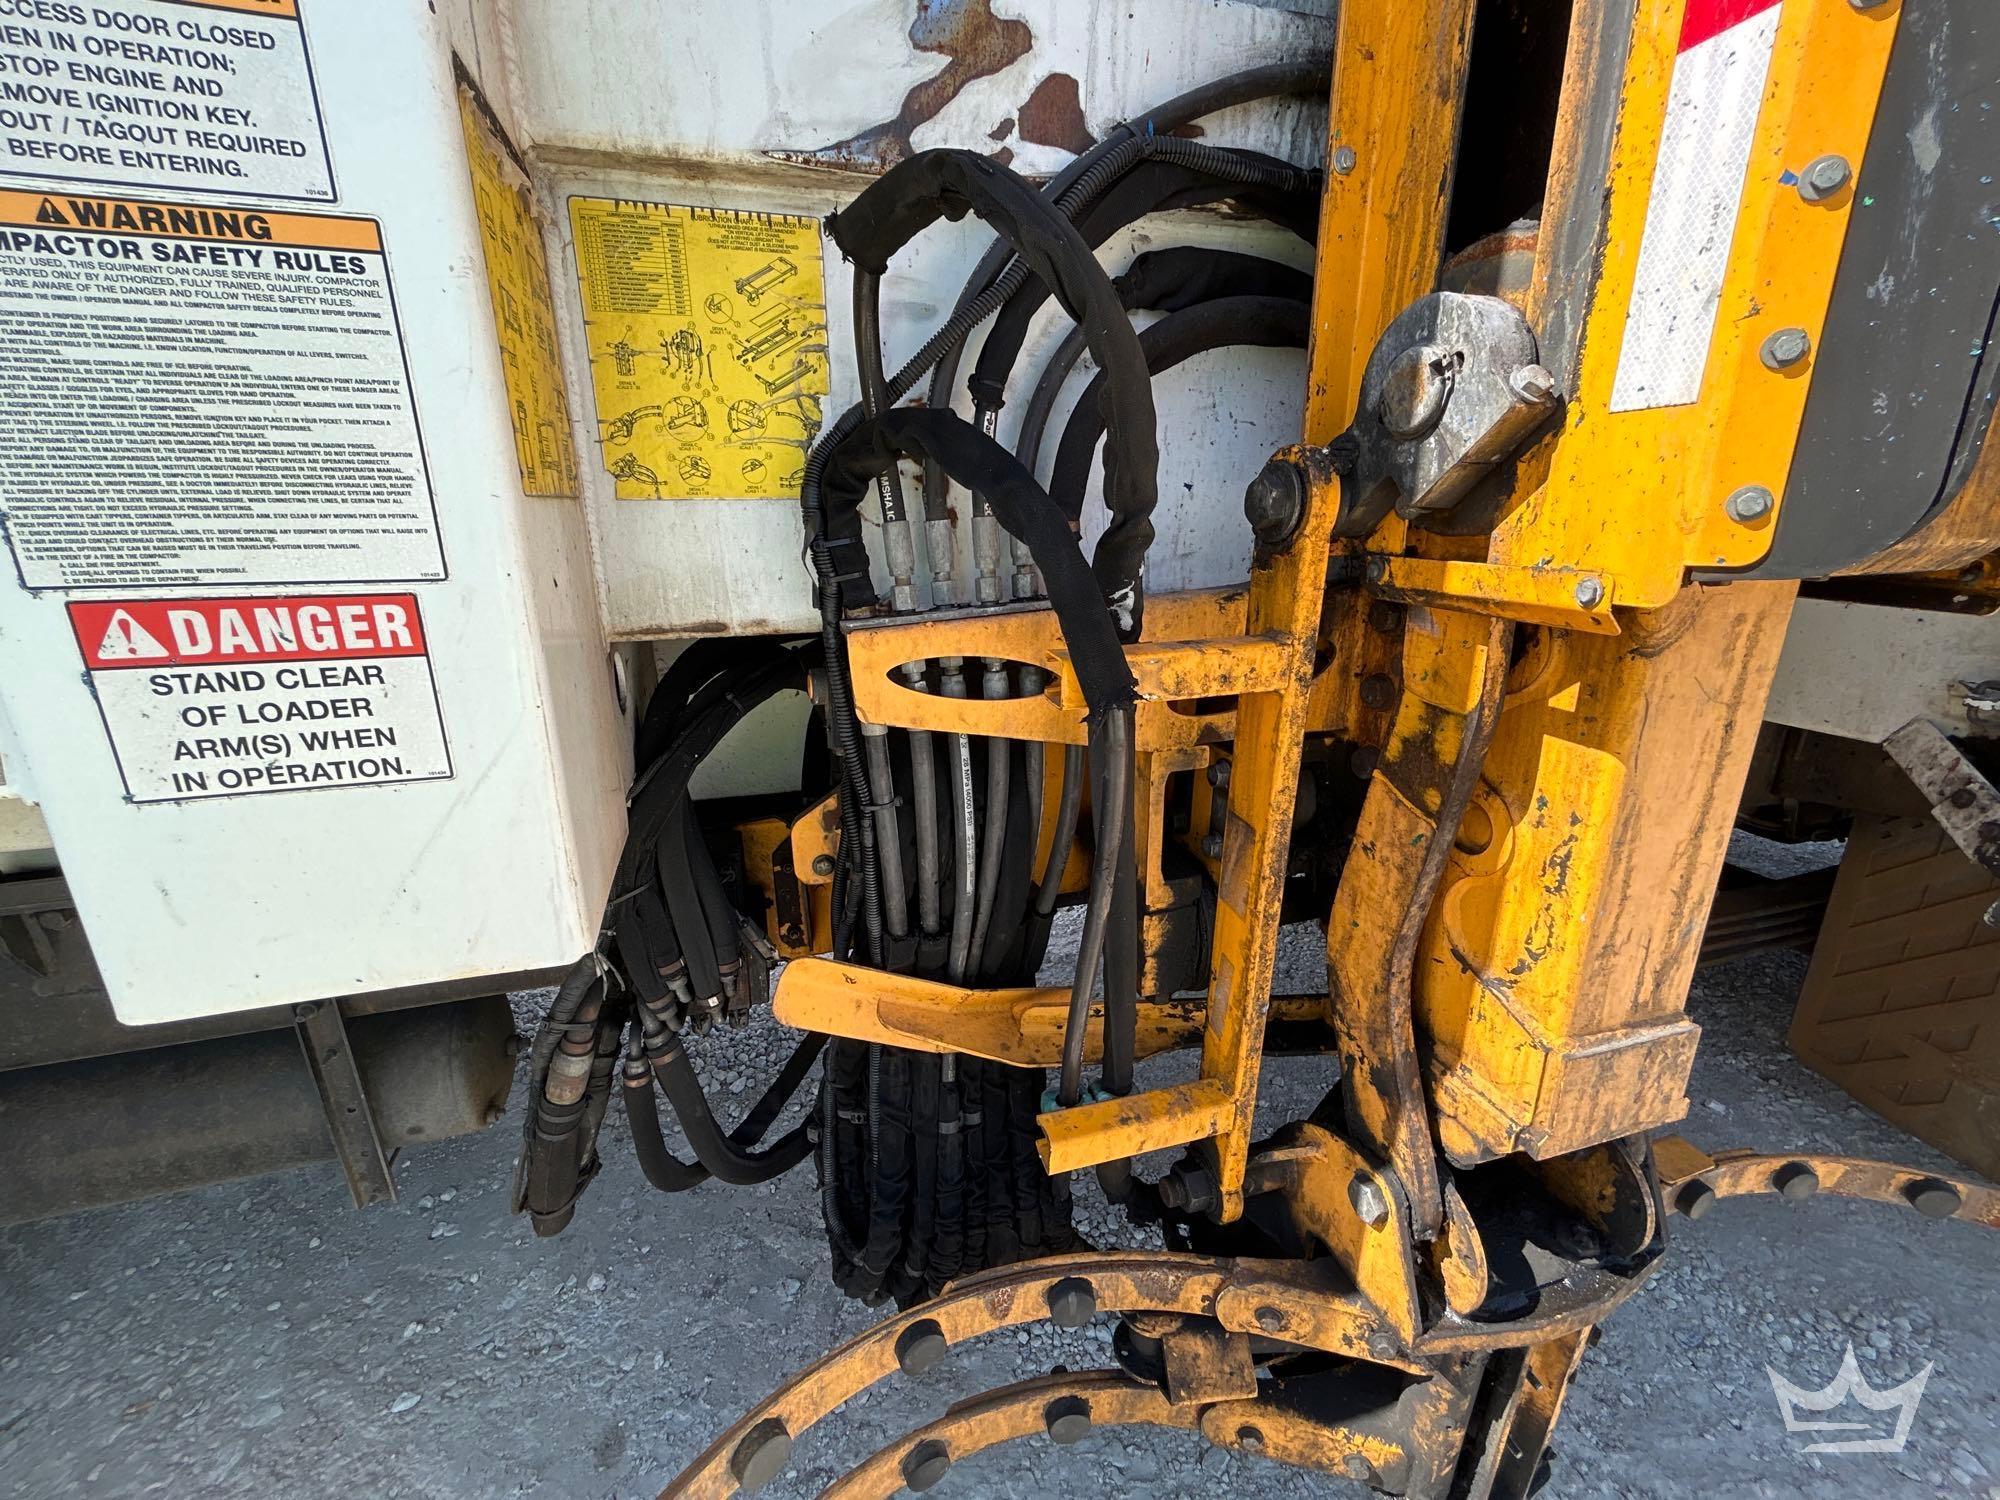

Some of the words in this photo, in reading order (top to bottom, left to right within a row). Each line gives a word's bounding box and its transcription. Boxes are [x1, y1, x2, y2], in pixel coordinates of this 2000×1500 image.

[92, 9, 170, 36] DOOR
[177, 21, 275, 49] CLOSED
[0, 28, 42, 48] EN
[49, 34, 77, 52] IN
[83, 38, 235, 74] OPERATION;
[67, 63, 165, 90] ENGINE
[173, 76, 223, 97] AND
[0, 84, 82, 108] MOVE
[87, 93, 199, 120] IGNITION
[204, 106, 256, 127] KEY.
[63, 116, 68, 134] /
[76, 118, 177, 144] TAGOUT
[185, 130, 306, 156] REQUIRED
[9, 138, 113, 164] BEFORE
[119, 150, 247, 176] ENTERING.
[68, 200, 272, 240] WARNING
[29, 257, 66, 268] USED,
[67, 259, 96, 269] THIS
[97, 262, 163, 273] EQUIPMENT
[166, 266, 190, 275] CAN
[192, 268, 229, 278] CAUSE
[231, 270, 272, 280] SEVERE
[274, 273, 313, 283] INJURY.
[315, 276, 380, 287] COMPACTOR
[151, 243, 261, 267] SAFETY
[273, 251, 366, 275] RULES
[0, 267, 49, 278] ERATED
[51, 270, 81, 280] ONLY
[84, 272, 100, 281] BY
[103, 274, 178, 286] AUTHORIZED,
[180, 278, 212, 288] FULLY
[215, 280, 264, 292] TRAINED,
[266, 284, 320, 294] QUALIFIED
[322, 287, 383, 298] PERSONNEL
[4, 280, 30, 288] ARE
[32, 281, 74, 291] AWARE
[76, 284, 92, 292] OF
[96, 285, 118, 294] THE
[119, 286, 167, 296] DANGER
[169, 289, 192, 298] AND
[194, 291, 239, 300] FOLLOW
[243, 294, 276, 302] THESE
[278, 296, 316, 304] SAFETY
[319, 298, 355, 307] RULES.
[34, 292, 50, 301] THE
[50, 294, 78, 302] OWNER
[83, 296, 122, 304] OPERATOR
[122, 298, 153, 306] MANUAL
[153, 299, 169, 307] AND
[169, 300, 183, 308] ALL
[183, 301, 226, 310] COMPACTOR
[226, 303, 251, 311] SAFETY
[252, 305, 279, 313] DECALS
[278, 306, 320, 315] COMPLETELY
[321, 309, 346, 317] BEFORE
[346, 310, 382, 319] OPERATING
[0, 309, 42, 318] CONTAINER
[51, 312, 88, 321] PROPERLY
[89, 314, 132, 323] POSITIONED
[132, 316, 148, 324] AND
[149, 317, 183, 325] SECURELY
[184, 319, 215, 327] LATCHED
[240, 322, 281, 330] COMPACTOR
[281, 324, 307, 332] BEFORE
[307, 325, 339, 333] STARTING
[352, 328, 393, 336] COMPACTOR.
[880, 476, 894, 510] MSHA
[167, 605, 413, 654] DANGER
[150, 671, 265, 695] STAND
[276, 665, 384, 689] CLEAR
[181, 705, 226, 727] OF
[238, 698, 372, 723] LOADER
[175, 734, 291, 760] ARM(S)
[300, 728, 396, 750] WHEN
[172, 772, 208, 792] IN
[218, 757, 412, 788] OPERATION.
[963, 758, 970, 769] 28
